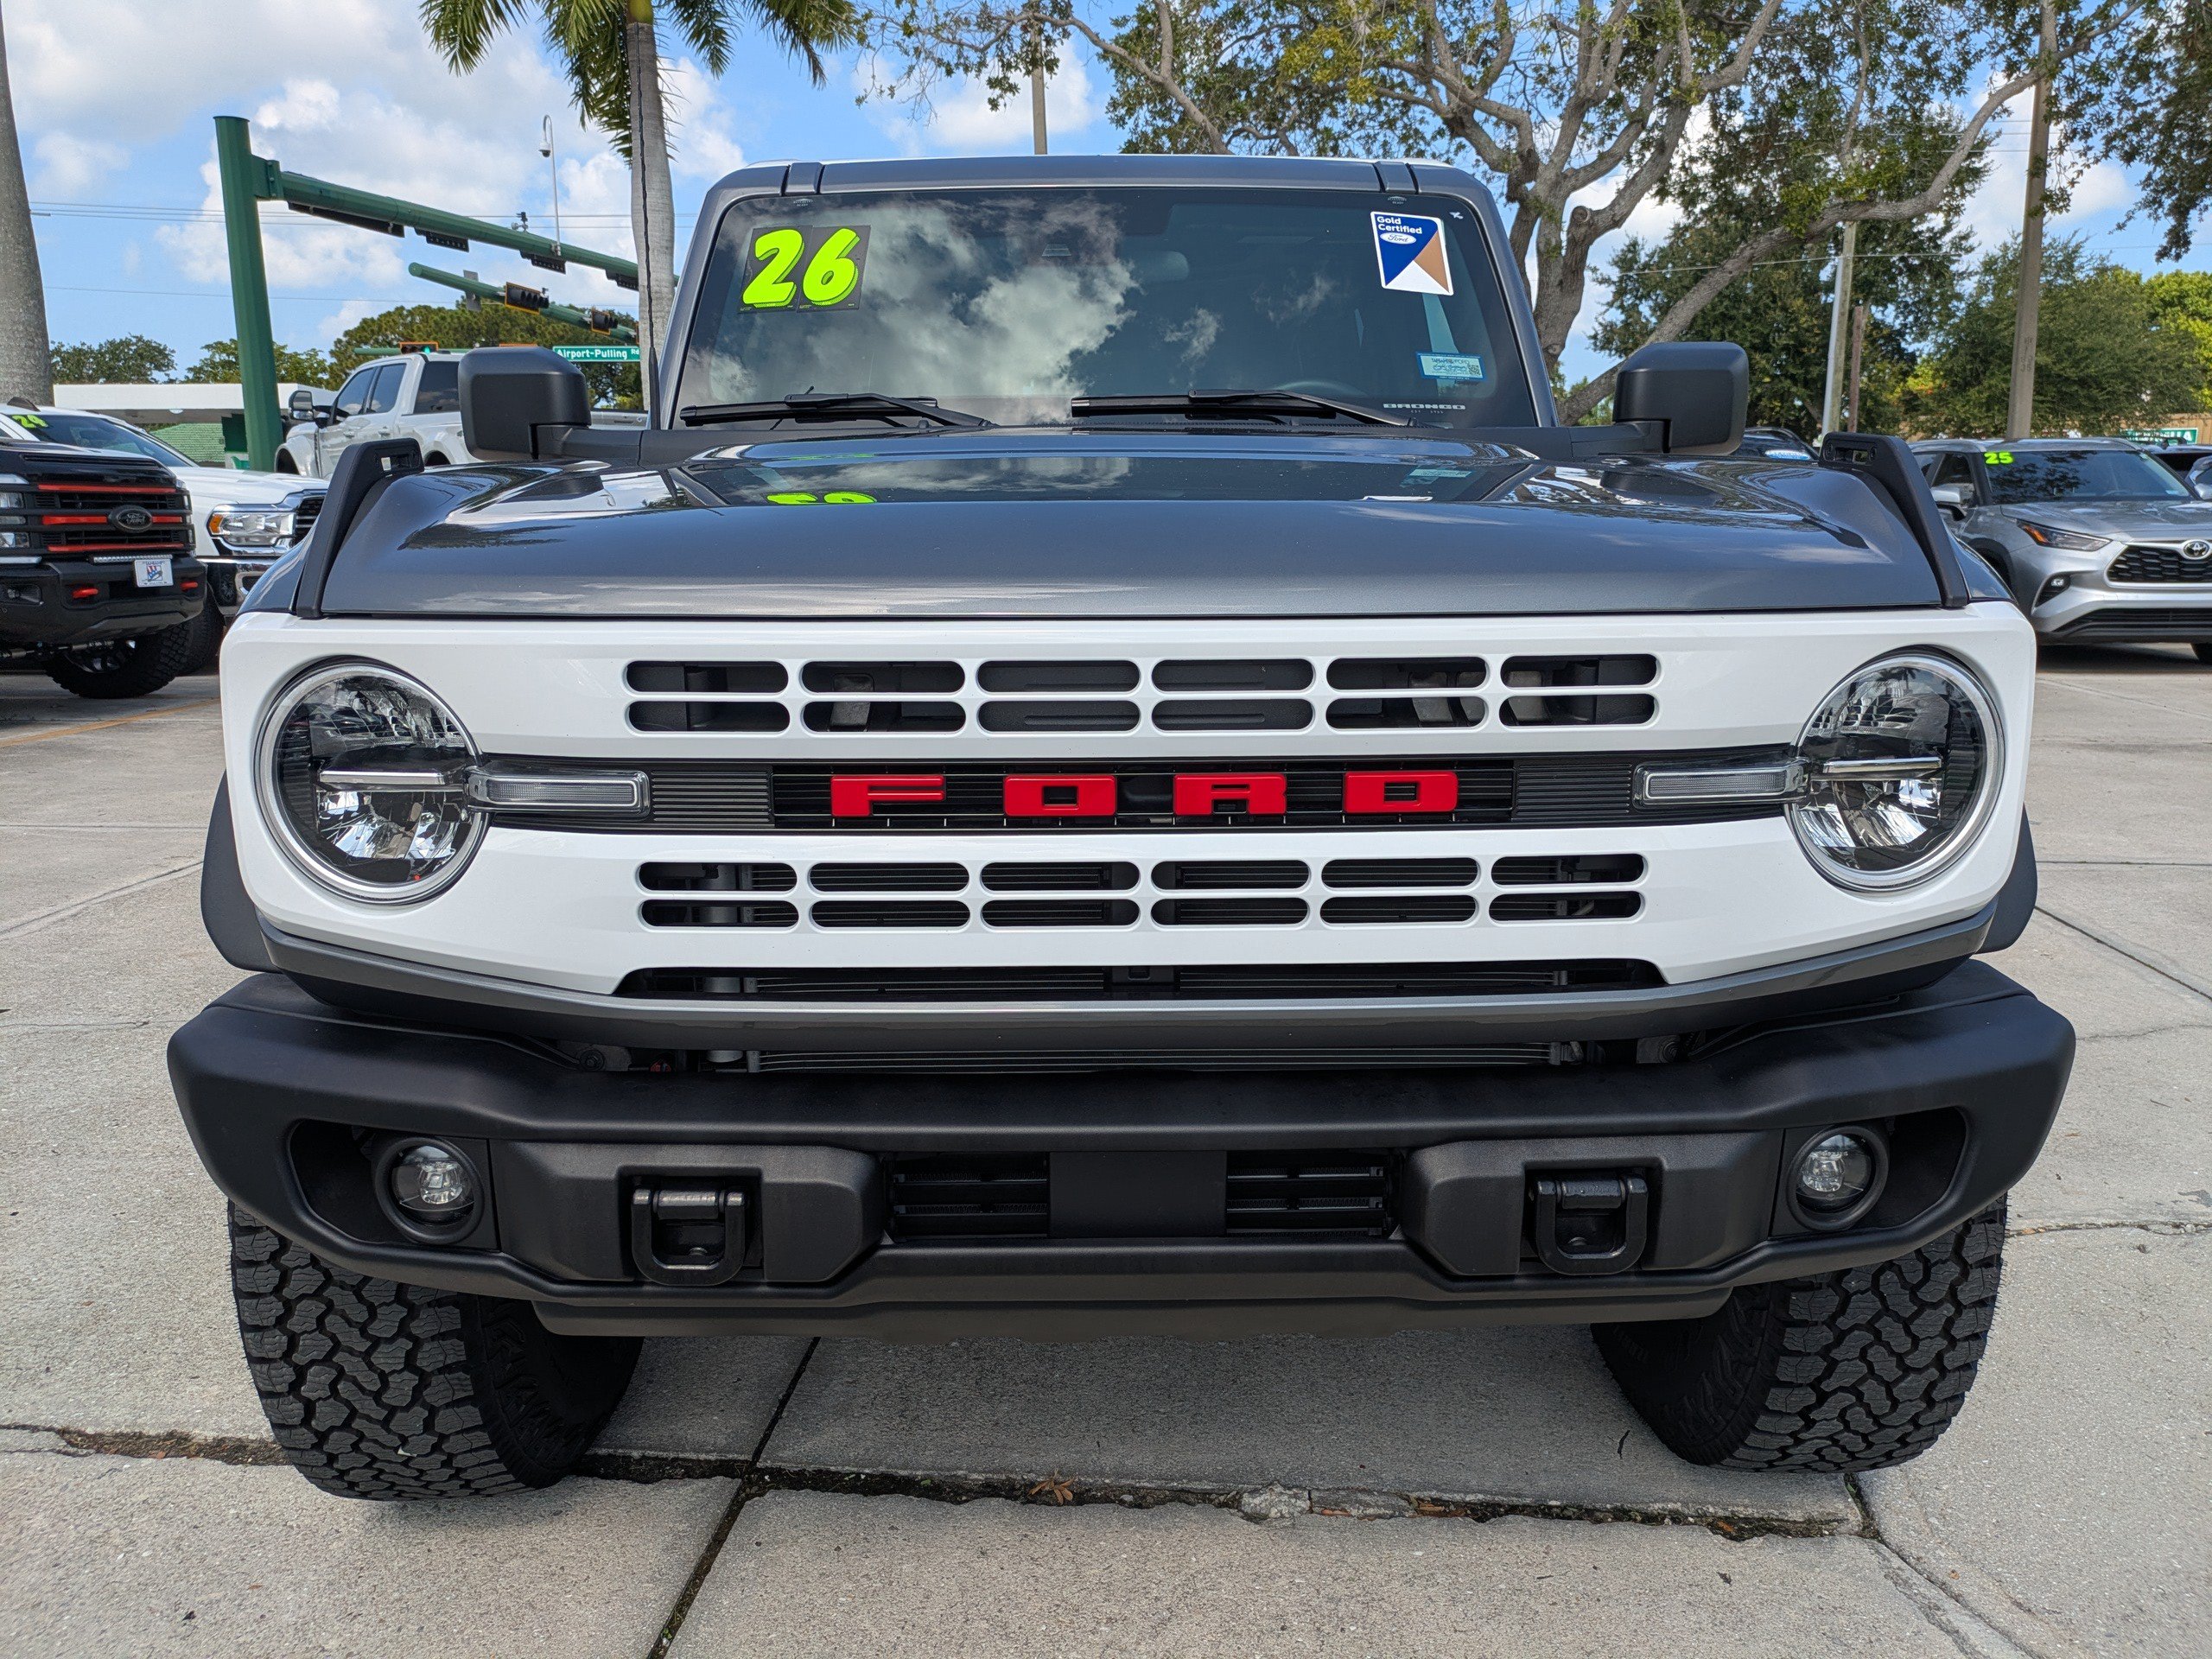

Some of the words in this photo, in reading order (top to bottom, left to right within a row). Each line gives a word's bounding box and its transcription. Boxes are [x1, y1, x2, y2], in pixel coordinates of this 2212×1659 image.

[1376, 216, 1402, 225] Gold
[1377, 224, 1423, 234] Certified
[1388, 234, 1409, 243] Ford
[742, 227, 861, 308] 26
[556, 349, 627, 359] Airport-Pulling
[11, 414, 49, 429] 24
[1984, 452, 2013, 465] 25
[830, 772, 1459, 817] FORD
